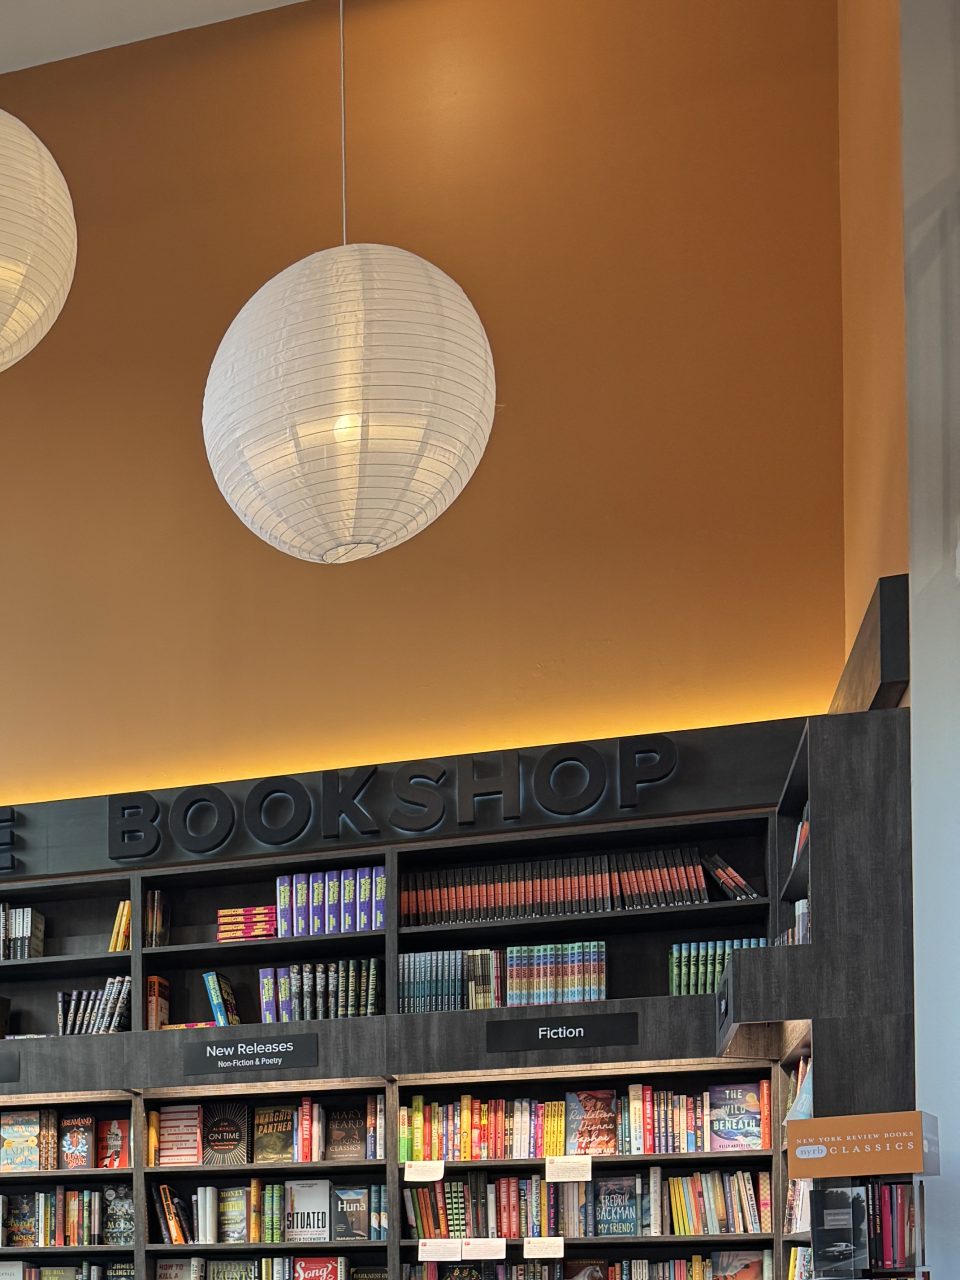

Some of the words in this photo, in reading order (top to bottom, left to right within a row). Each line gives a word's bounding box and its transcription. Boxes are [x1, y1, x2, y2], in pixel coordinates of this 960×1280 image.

[108, 735, 679, 861] BOOKSHOP
[538, 1025, 585, 1039] Fiction
[206, 1044, 234, 1056] New
[237, 1040, 294, 1054] Releases
[218, 1059, 254, 1068] Non-Fiction
[261, 1056, 283, 1067] Poetry
[725, 1090, 742, 1099] THE
[331, 1110, 361, 1119] MARY
[722, 1105, 746, 1114] WILD
[258, 1121, 292, 1134] PANTHER
[330, 1120, 363, 1129] BEARD
[713, 1120, 756, 1130] BENEATH
[800, 1146, 823, 1157] nyrb
[830, 1142, 914, 1154] CLASSICS
[338, 1201, 366, 1212] Huna
[601, 1194, 630, 1207] FREDRIK
[597, 1206, 636, 1220] BACKMAN
[287, 1211, 327, 1229] SITUATED
[598, 1223, 607, 1233] MY
[610, 1222, 634, 1232] FRIENDS
